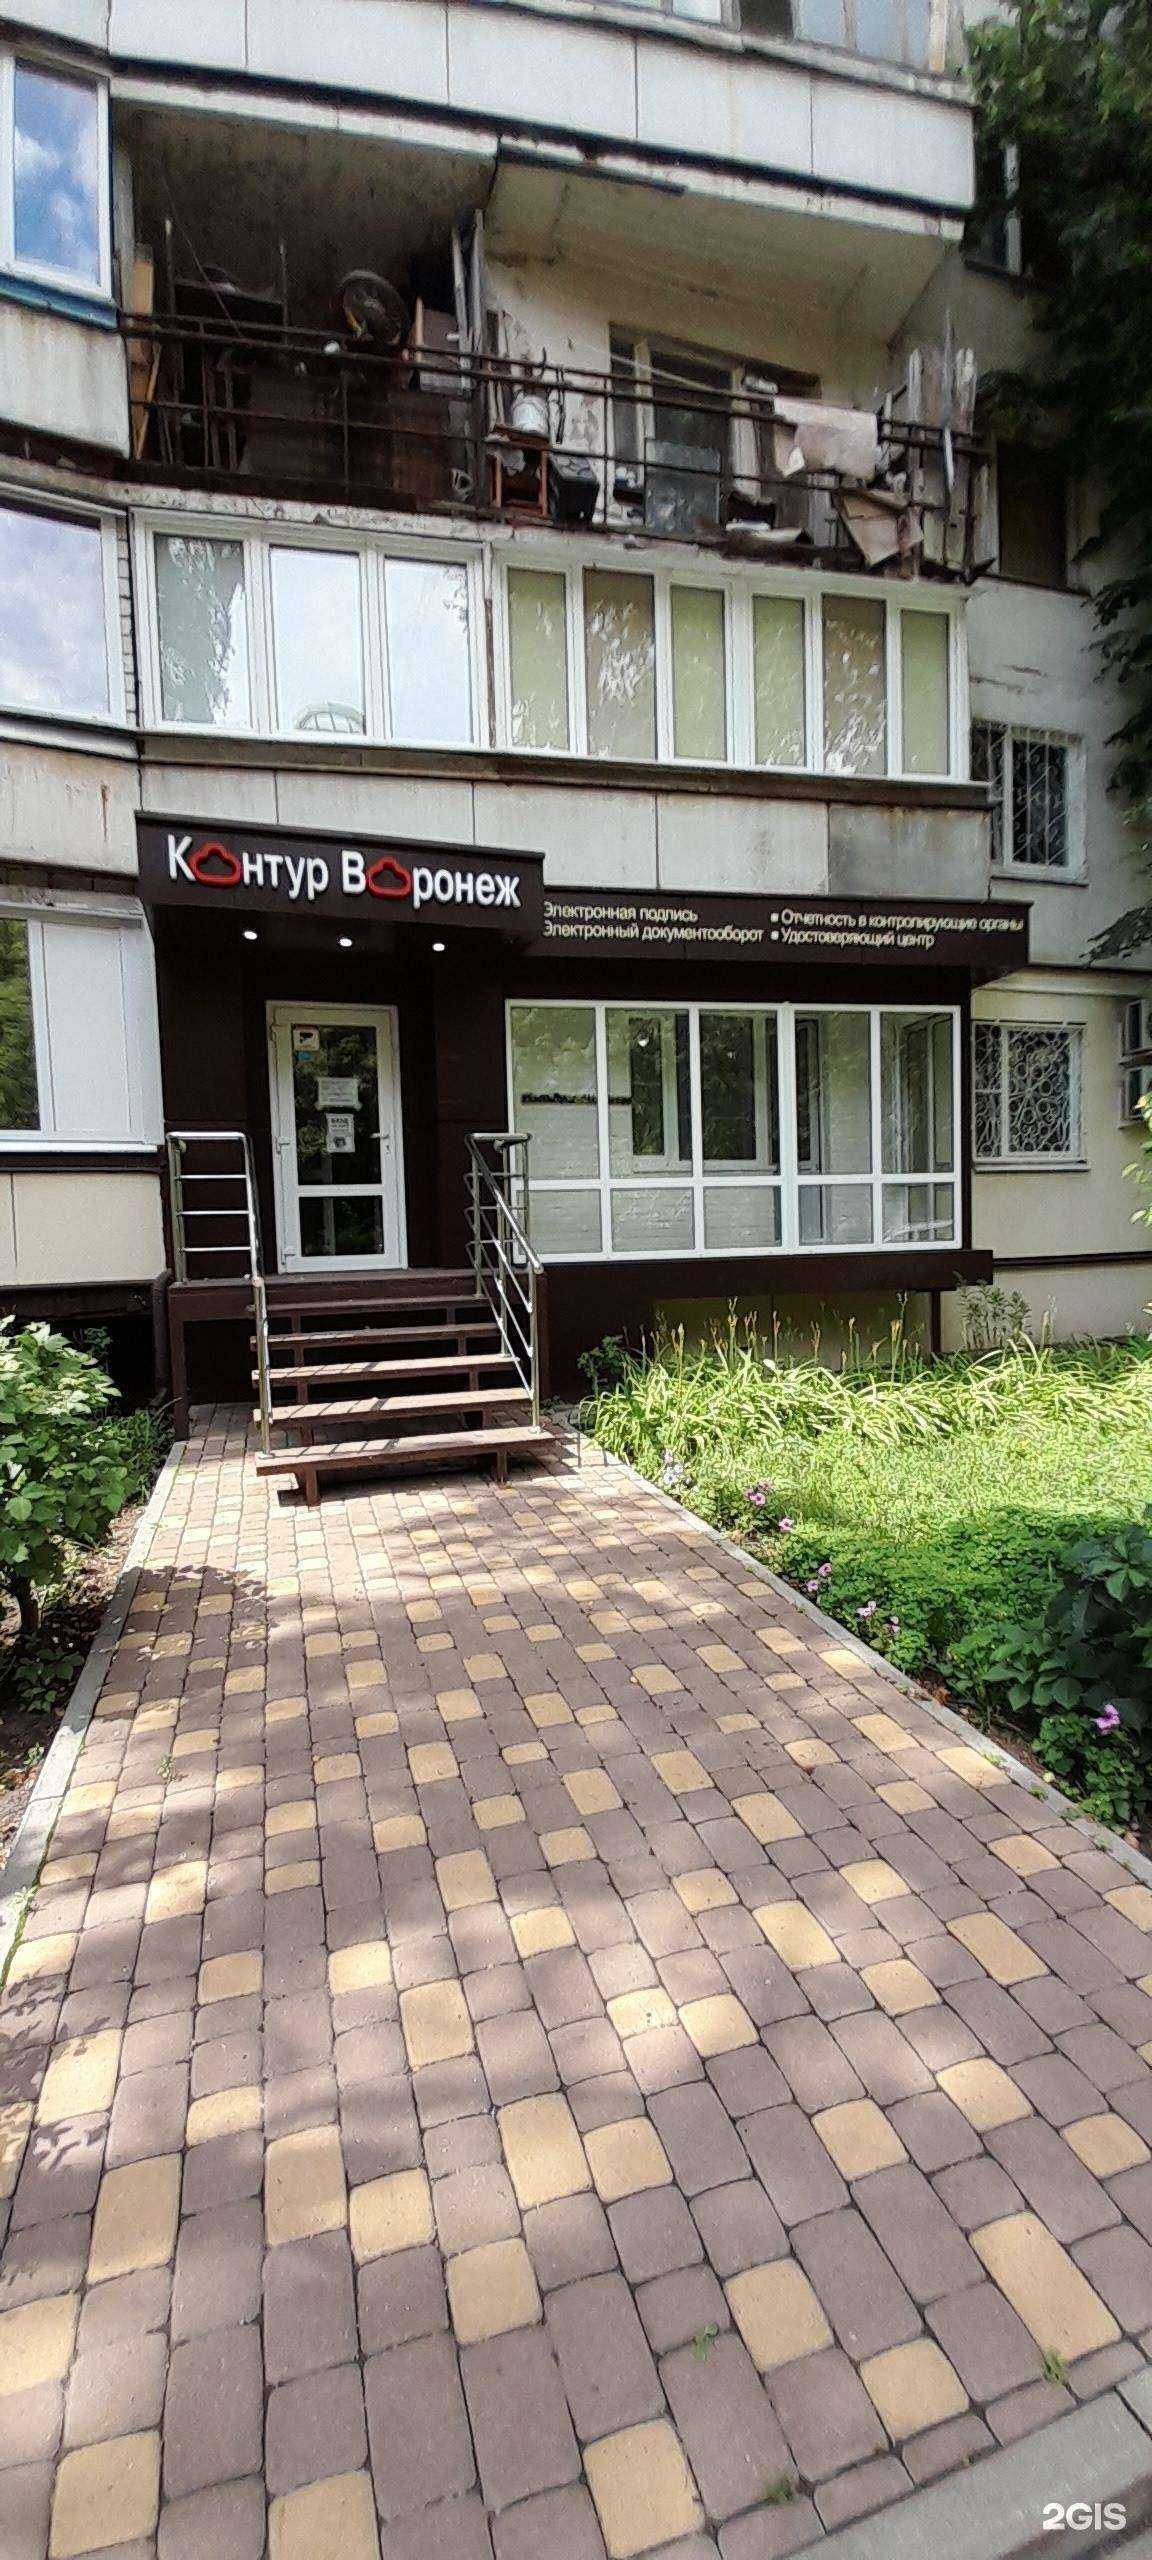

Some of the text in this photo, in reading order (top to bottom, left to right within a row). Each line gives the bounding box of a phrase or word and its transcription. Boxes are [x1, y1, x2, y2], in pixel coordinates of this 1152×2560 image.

[167, 833, 523, 909] Контур Воронеж
[543, 900, 699, 923] Электронная подпись
[780, 908, 1024, 932] Отчетность в контролирующие органы
[543, 919, 764, 945] Электронный документооборот
[780, 926, 936, 949] Удостоверяющий центр
